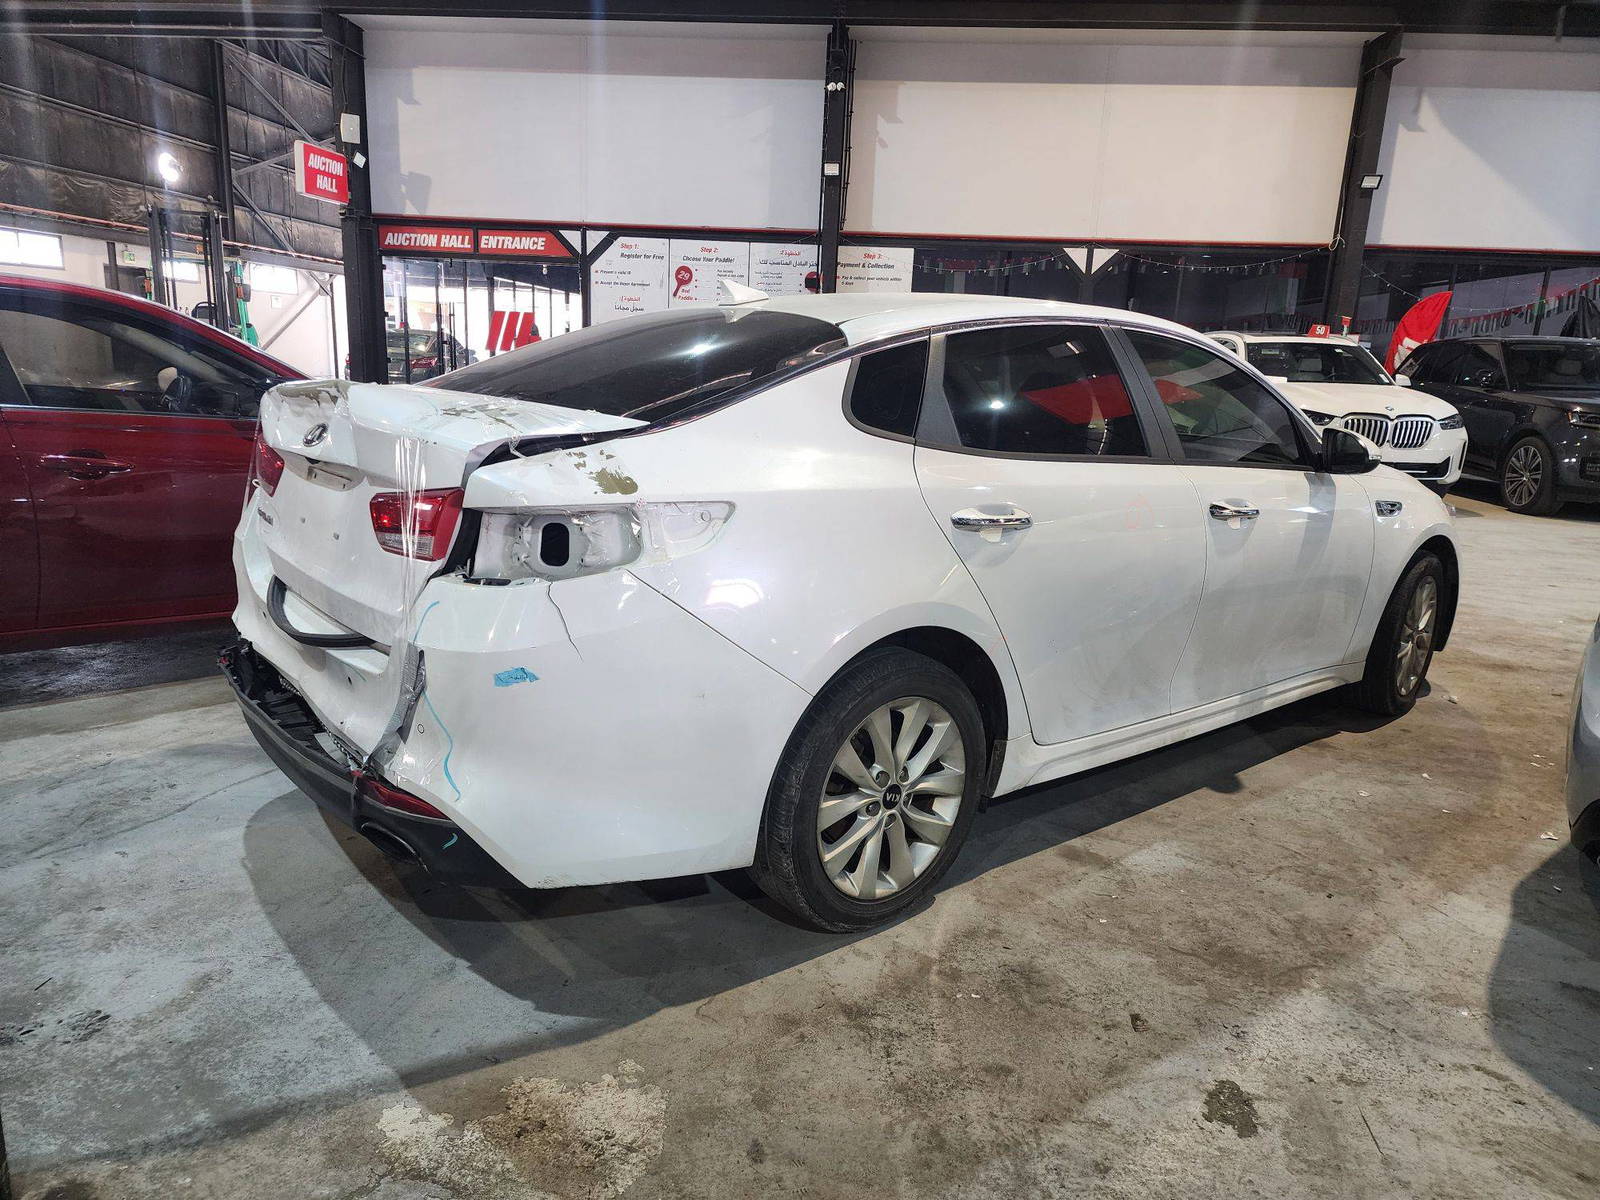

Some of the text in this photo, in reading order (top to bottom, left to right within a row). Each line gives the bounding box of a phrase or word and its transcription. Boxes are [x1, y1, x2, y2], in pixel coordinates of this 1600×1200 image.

[308, 152, 343, 176] AUCTION
[316, 173, 338, 193] HALL
[384, 232, 546, 250] AUCTION HALL ENTRANCE
[620, 242, 633, 250] Step
[620, 252, 643, 260] Register
[678, 270, 690, 280] 29
[1315, 325, 1326, 335] 50
